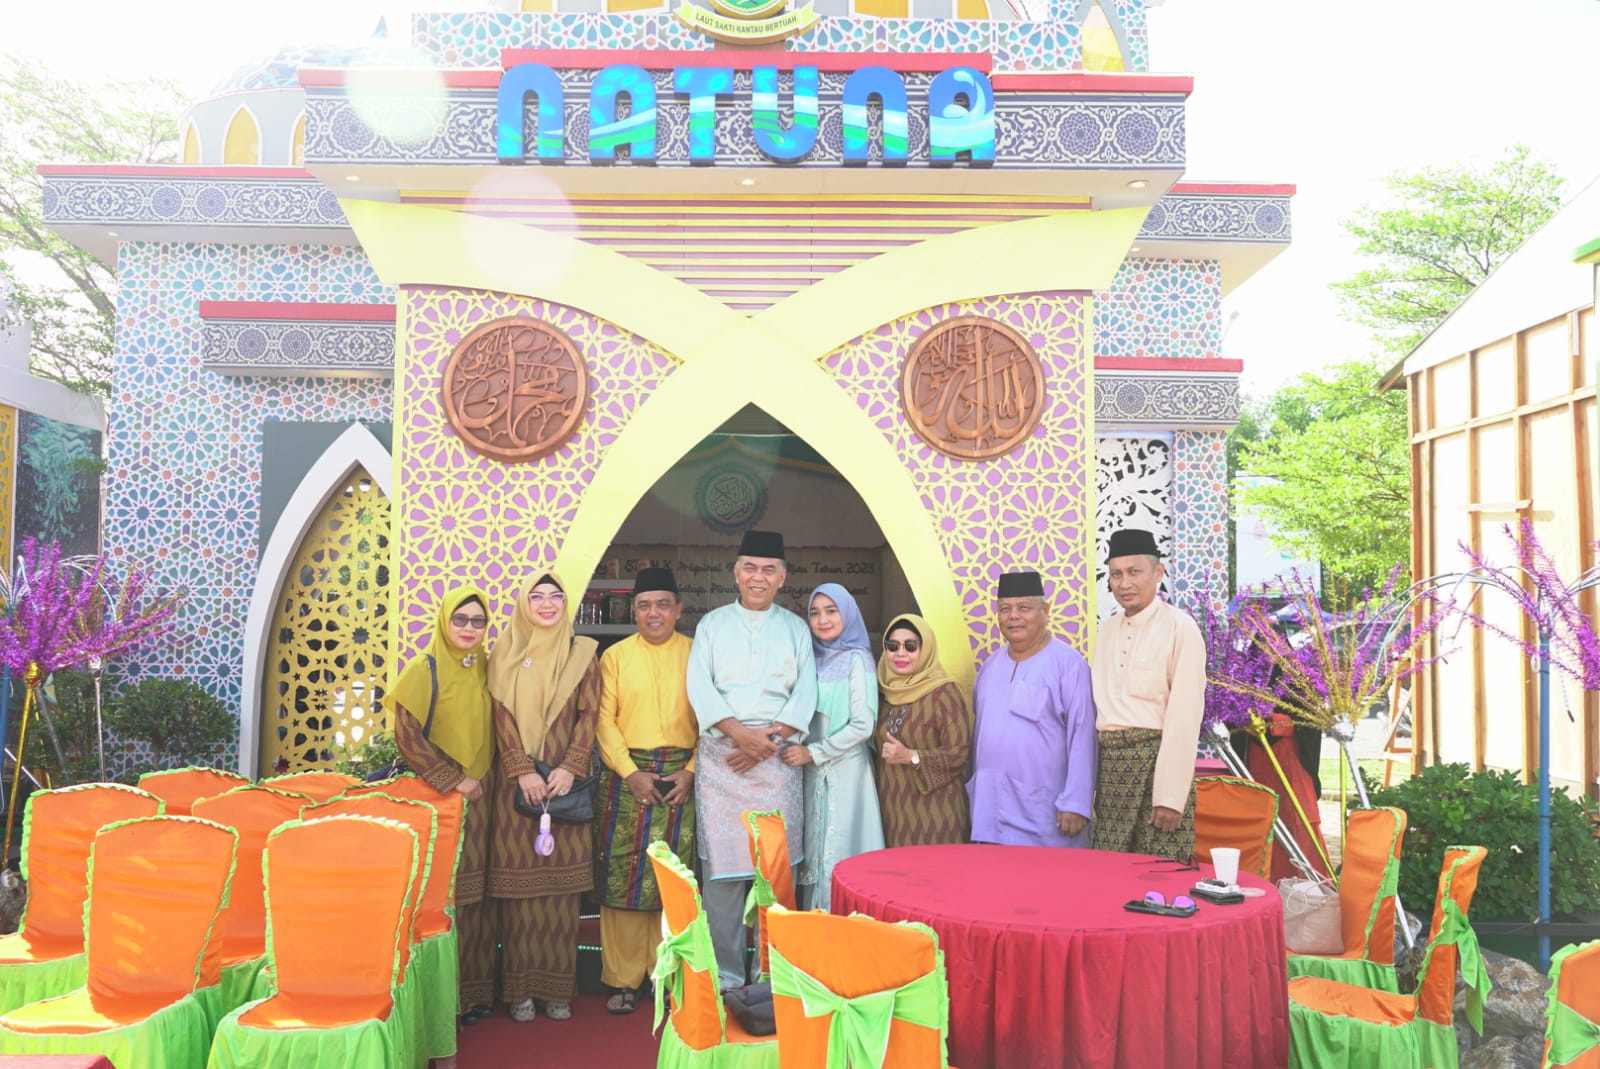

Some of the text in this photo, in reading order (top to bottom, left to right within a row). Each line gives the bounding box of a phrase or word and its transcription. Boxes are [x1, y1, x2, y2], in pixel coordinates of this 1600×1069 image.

[695, 13, 797, 34] LAUT SAKTI RANTAU BERTUAH
[497, 63, 996, 166] NATUNA
